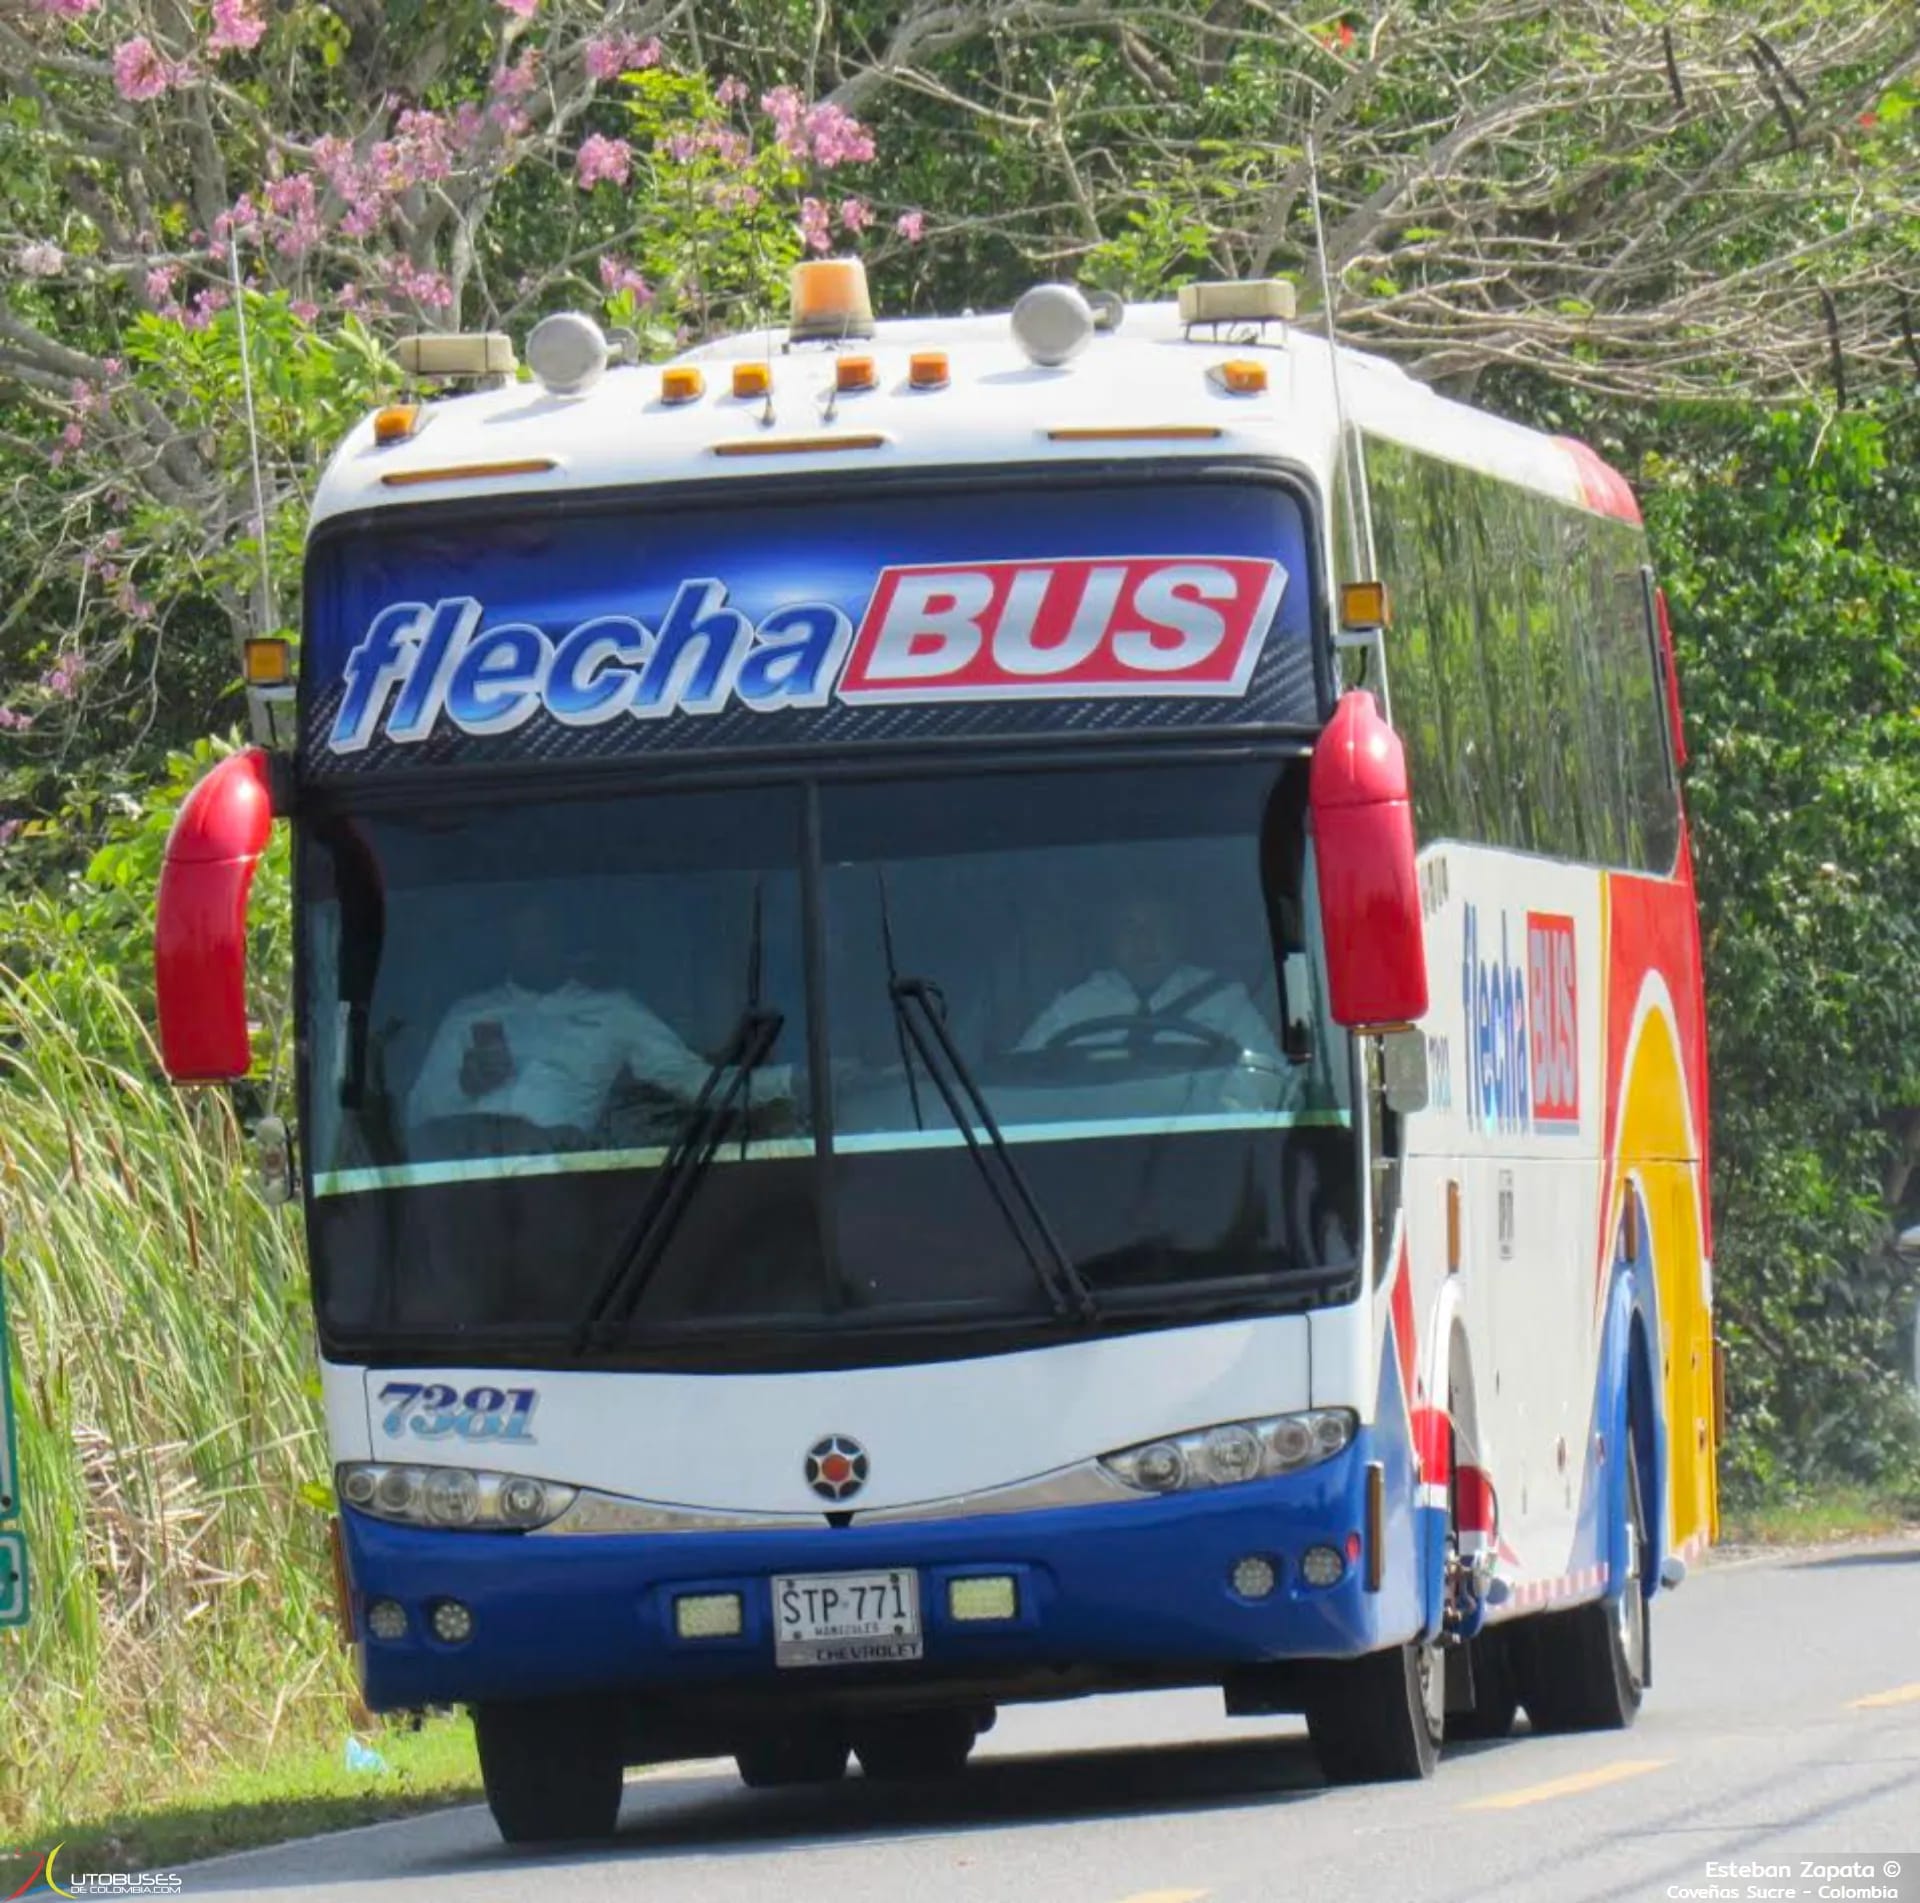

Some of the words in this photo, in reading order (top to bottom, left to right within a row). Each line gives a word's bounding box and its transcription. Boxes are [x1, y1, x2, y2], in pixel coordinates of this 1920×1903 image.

[864, 563, 1237, 682] BUS
[1532, 930, 1576, 1106] BUS
[379, 1382, 540, 1445] 7381
[816, 1642, 918, 1662] CHEVROLET
